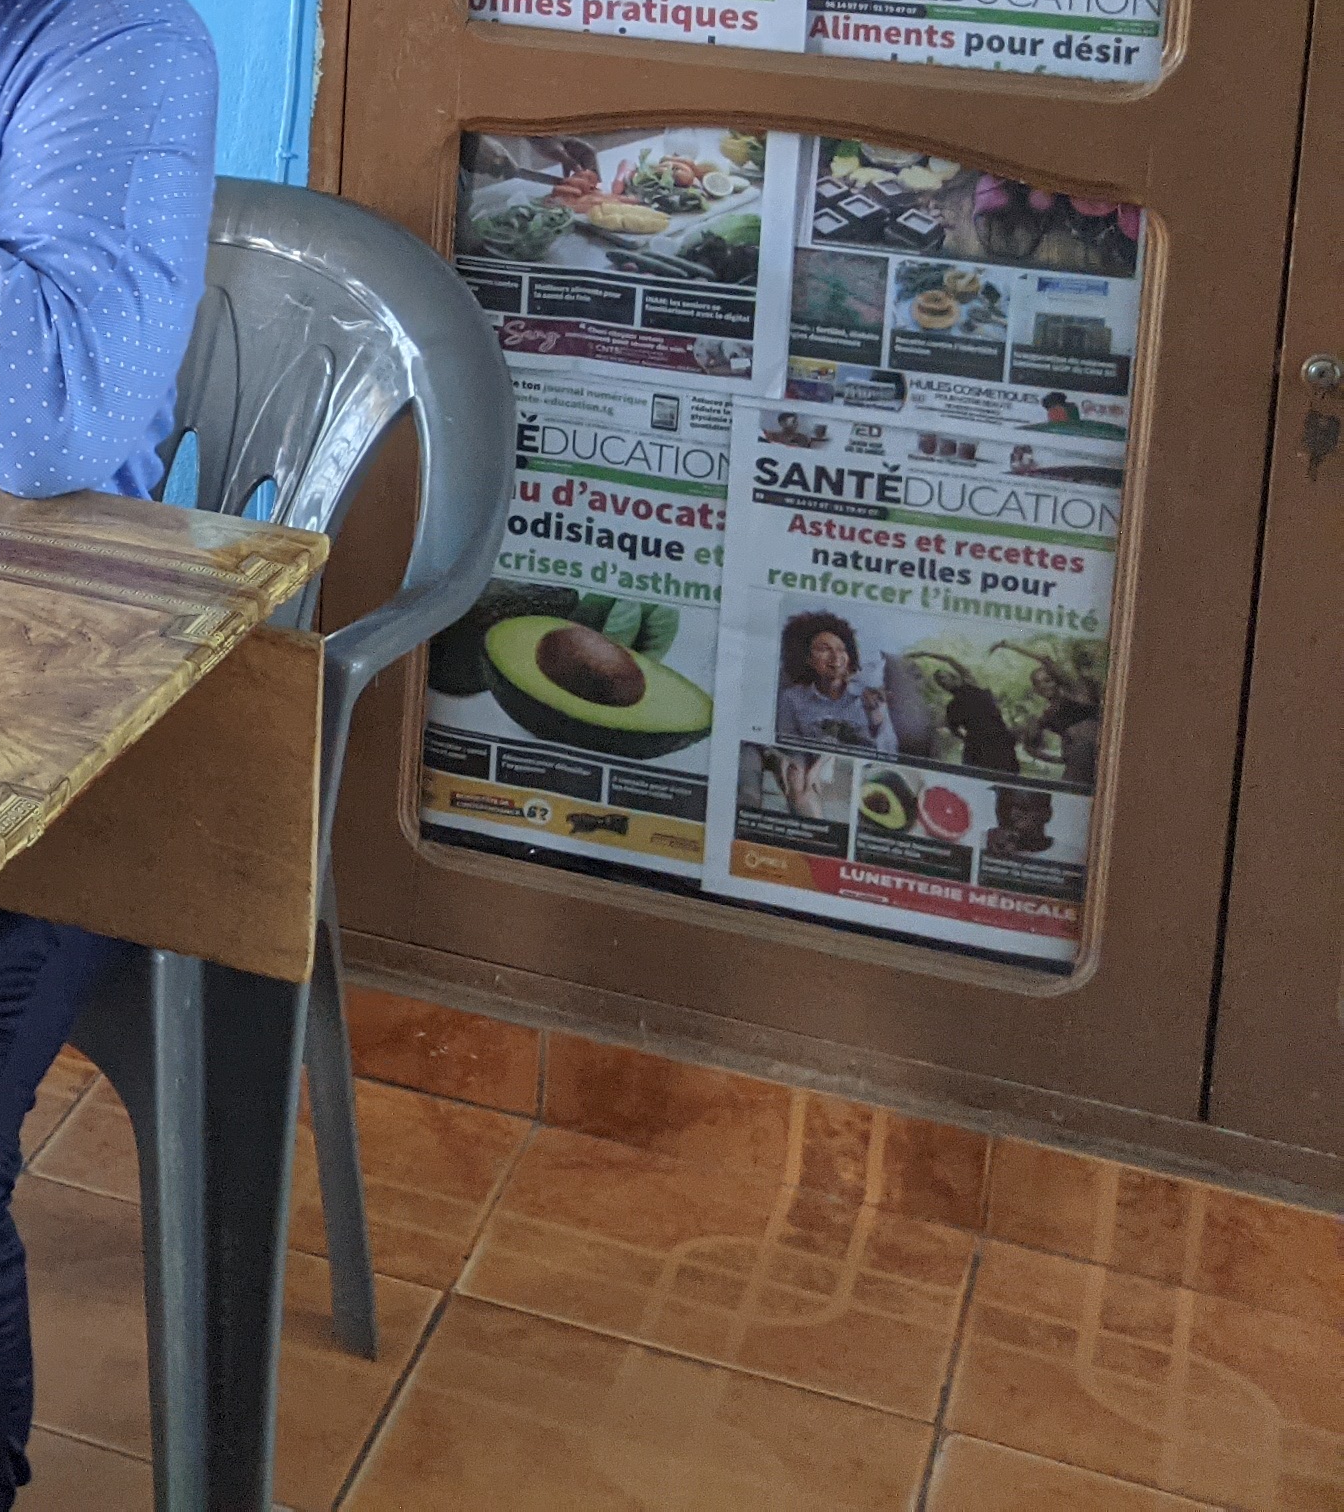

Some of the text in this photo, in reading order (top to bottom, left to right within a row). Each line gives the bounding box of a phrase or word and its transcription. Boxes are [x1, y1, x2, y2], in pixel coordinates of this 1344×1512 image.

[808, 14, 1141, 67] Aliments pour désir
[723, 312, 750, 323] digital
[522, 380, 648, 406] ton journal numérique
[910, 379, 953, 394] HUILES
[507, 509, 685, 564] odisiaque
[787, 512, 1086, 575] Astuces et recettes
[498, 550, 584, 582] crises
[810, 545, 1057, 598] naturelles pour
[767, 565, 1100, 633] renforcer l'immunité
[839, 865, 963, 903] LUNETTERIE
